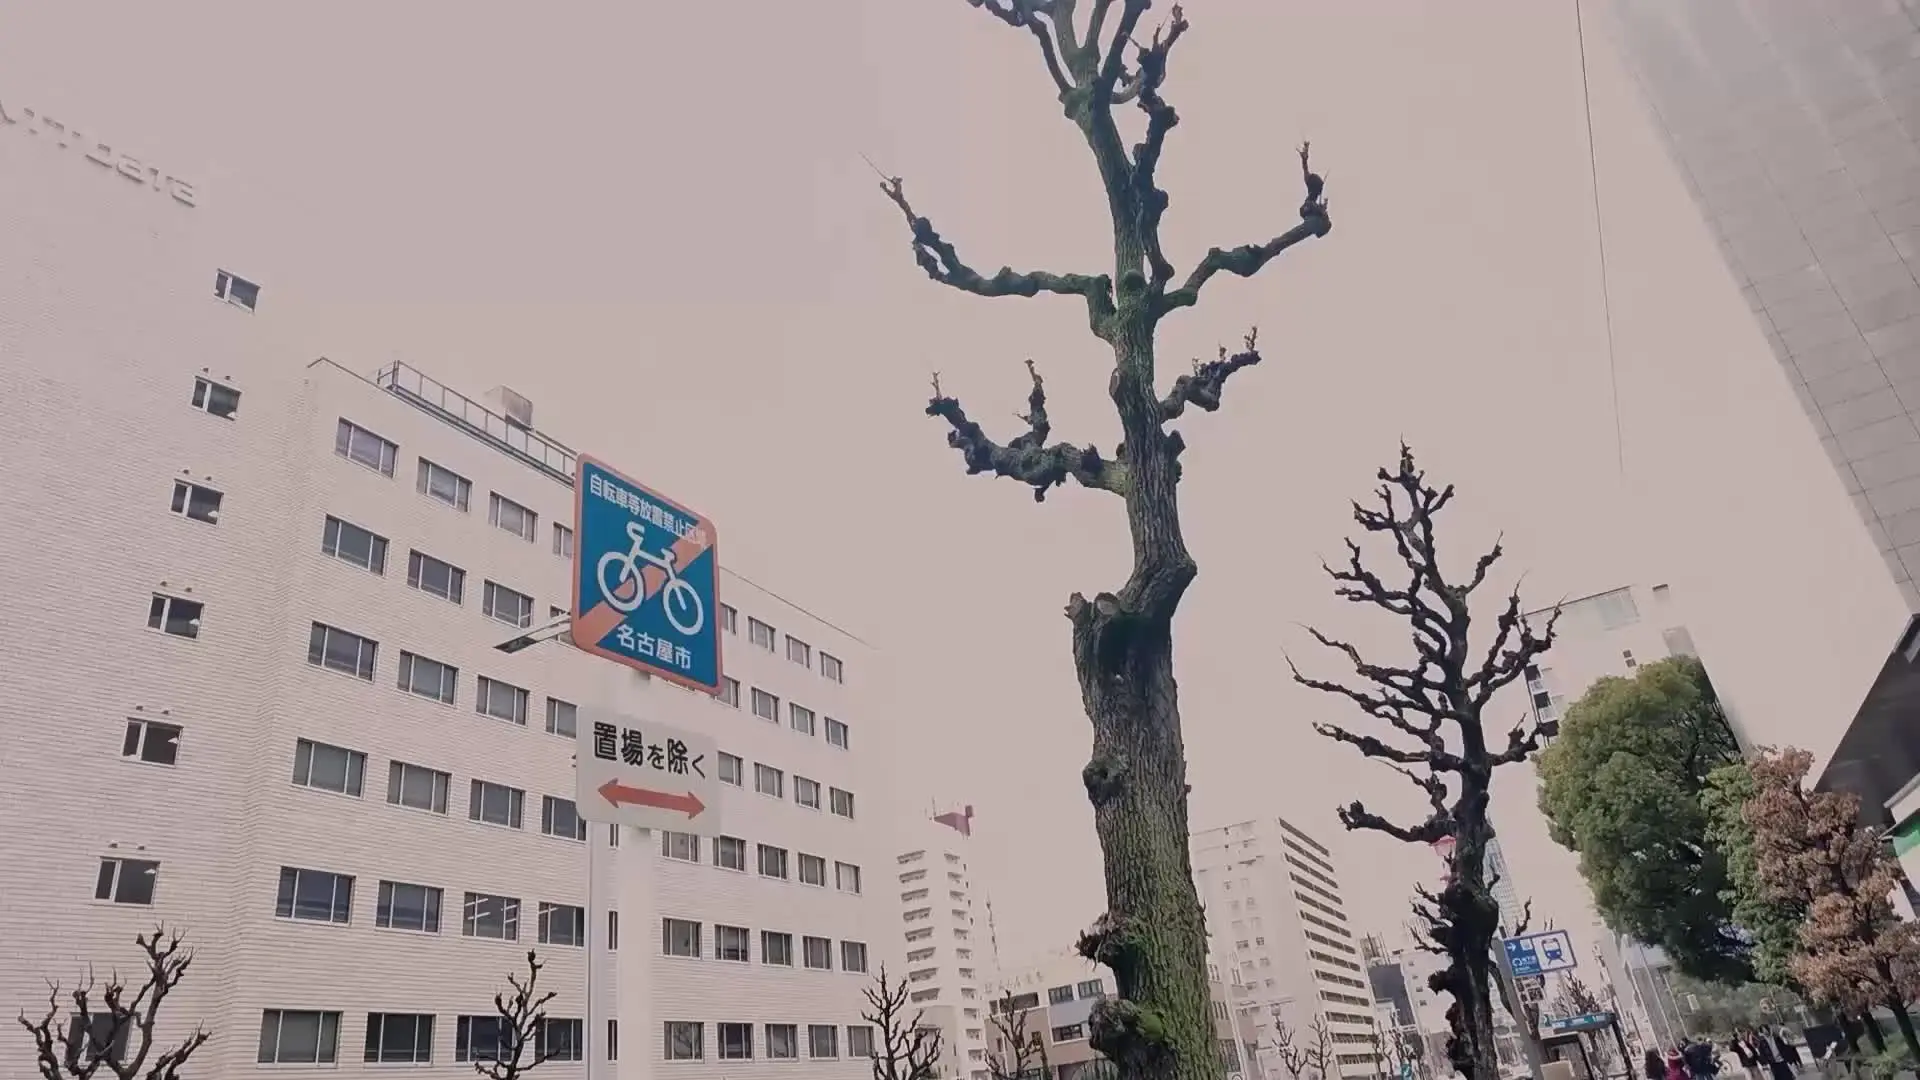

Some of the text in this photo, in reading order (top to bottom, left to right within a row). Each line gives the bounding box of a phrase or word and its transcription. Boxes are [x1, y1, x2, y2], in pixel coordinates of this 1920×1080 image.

[616, 623, 692, 669] 名古屋市
[594, 721, 705, 779] 置場を除く
